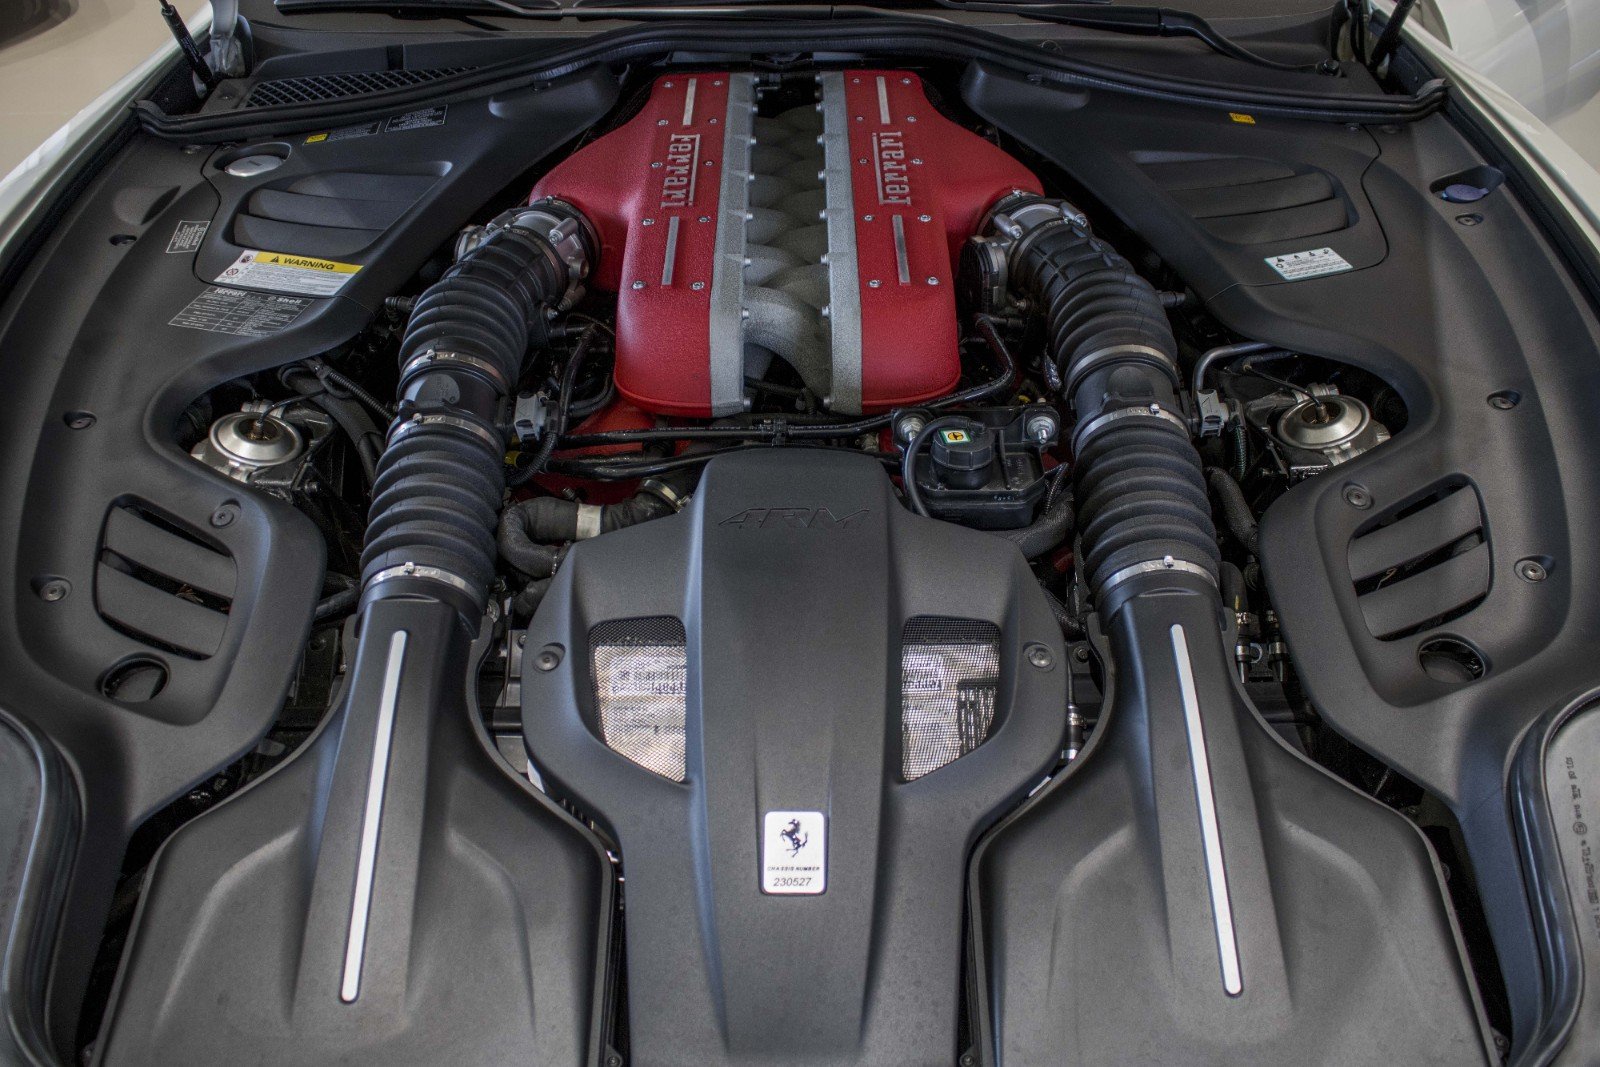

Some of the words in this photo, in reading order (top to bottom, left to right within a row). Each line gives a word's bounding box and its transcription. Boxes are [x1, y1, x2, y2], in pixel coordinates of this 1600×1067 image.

[661, 133, 702, 208] Ferrari
[873, 130, 912, 206] Ferrari
[283, 257, 335, 270] WARNING
[773, 877, 812, 887] 230527
